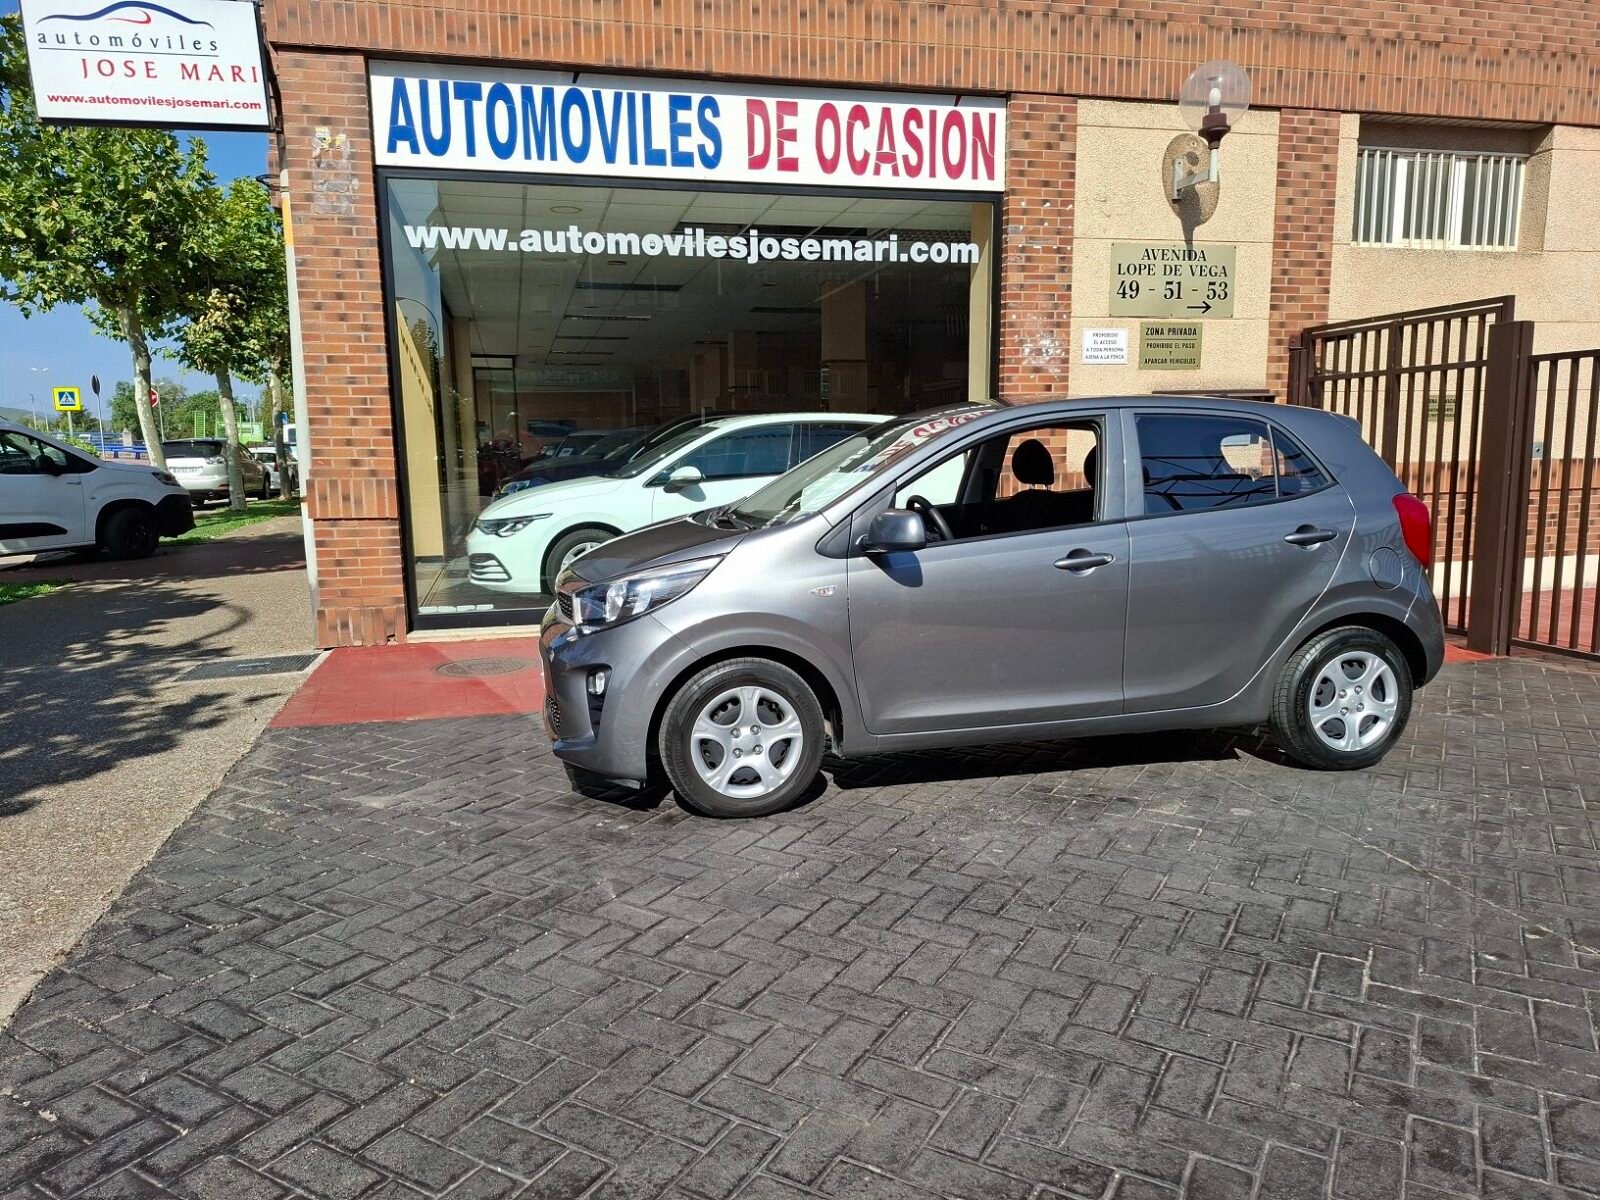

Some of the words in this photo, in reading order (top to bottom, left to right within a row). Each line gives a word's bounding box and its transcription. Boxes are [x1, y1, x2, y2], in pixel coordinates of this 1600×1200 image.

[37, 32, 218, 51] automóviles
[82, 59, 157, 79] JOSE
[181, 62, 258, 84] MARI
[47, 93, 262, 111] www.automovilesjosemari.com
[747, 99, 799, 173] DE
[403, 223, 980, 264] www.automovilesjosemari.com
[1141, 248, 1207, 262] AVENIDA
[1117, 263, 1156, 276] LOPE
[1163, 264, 1182, 277] DE
[1189, 265, 1228, 277] VEGA
[1116, 280, 1140, 299] 49
[1164, 281, 1183, 300] 51
[1206, 281, 1229, 300] 53
[1145, 327, 1165, 336] ZONA
[1167, 327, 1198, 336] PRIVADA
